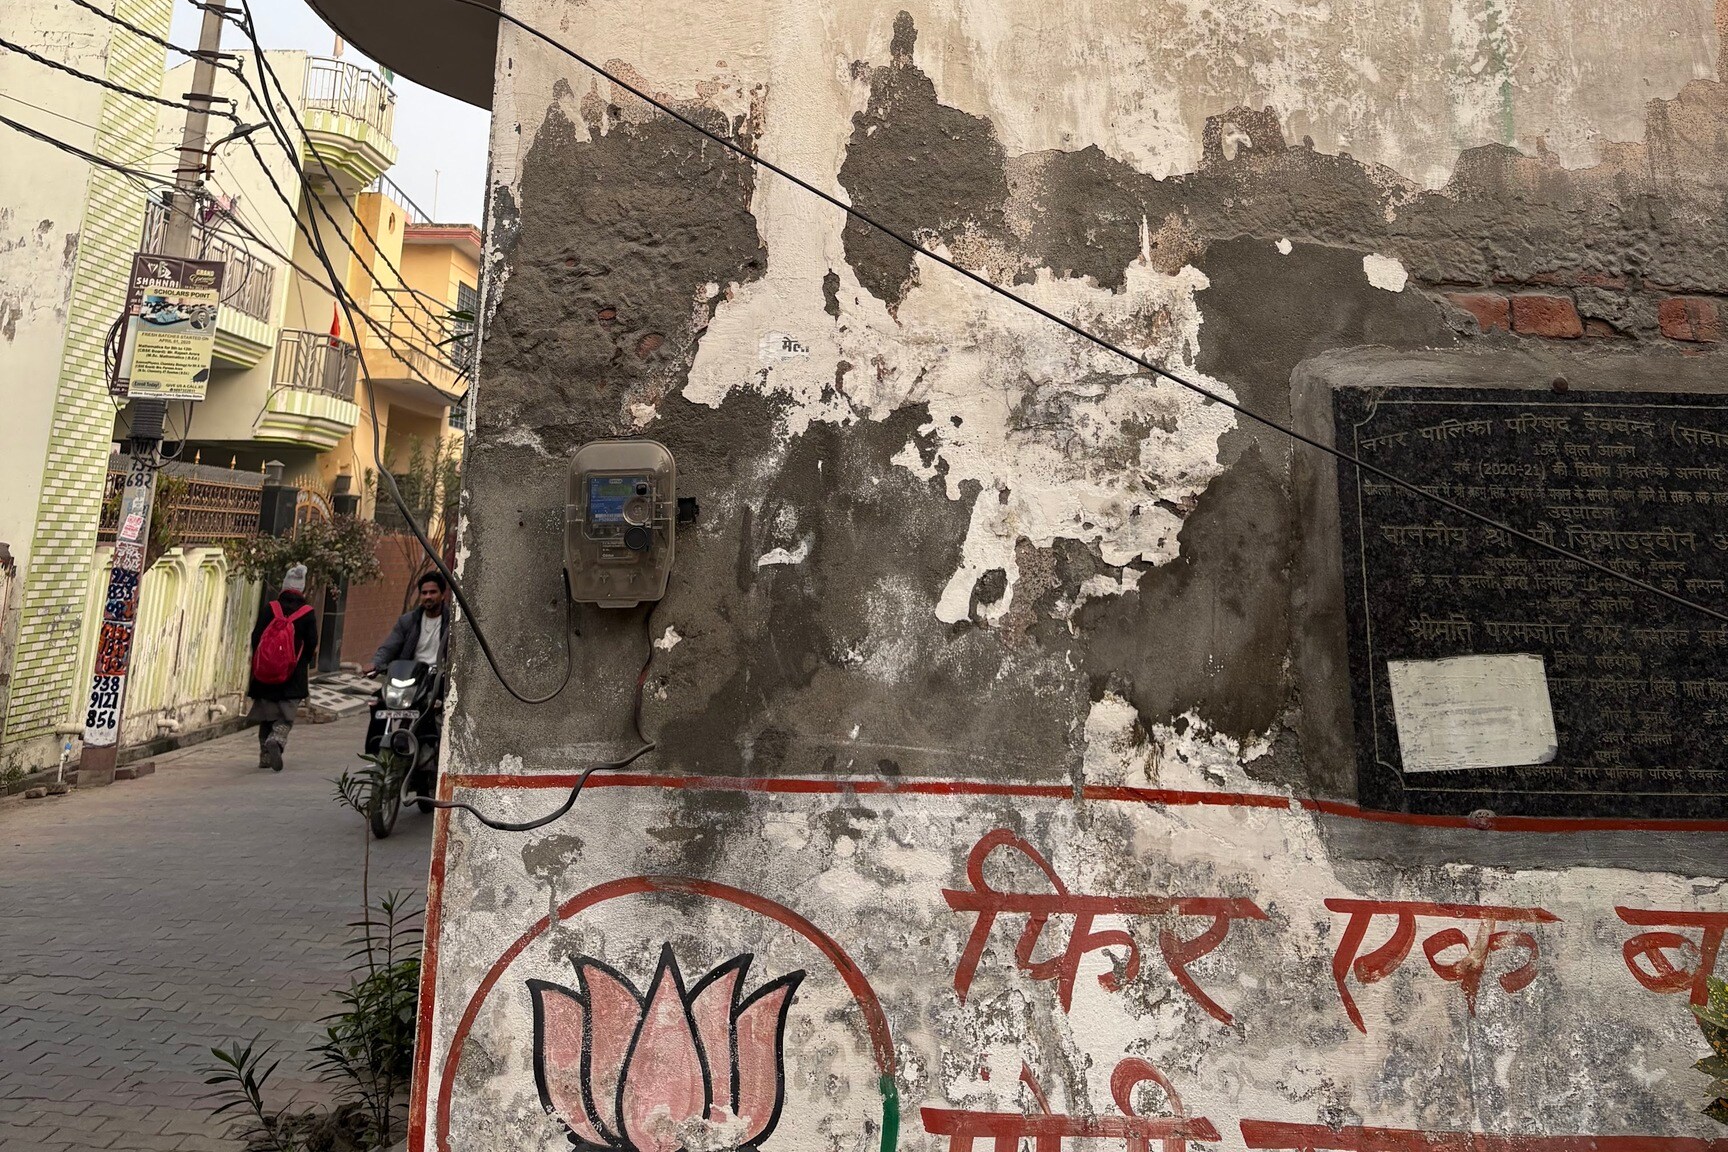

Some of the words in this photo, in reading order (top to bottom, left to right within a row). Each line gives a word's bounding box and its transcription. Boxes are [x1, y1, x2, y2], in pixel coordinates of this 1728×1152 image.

[136, 277, 180, 289] SHAHNAI
[154, 289, 189, 297] SCHOLARS
[190, 291, 210, 299] POINT
[1360, 431, 1409, 452] नगर
[1419, 418, 1493, 444] पालिका
[1504, 412, 1571, 434] परिषद
[1671, 419, 1728, 448] (सहा
[1380, 520, 1468, 547] माननीय
[1483, 616, 1571, 645] परमजीत
[92, 675, 120, 692] 938
[86, 710, 116, 730] 856
[941, 827, 1268, 1026] फिर
[1324, 897, 1563, 1035] एक
